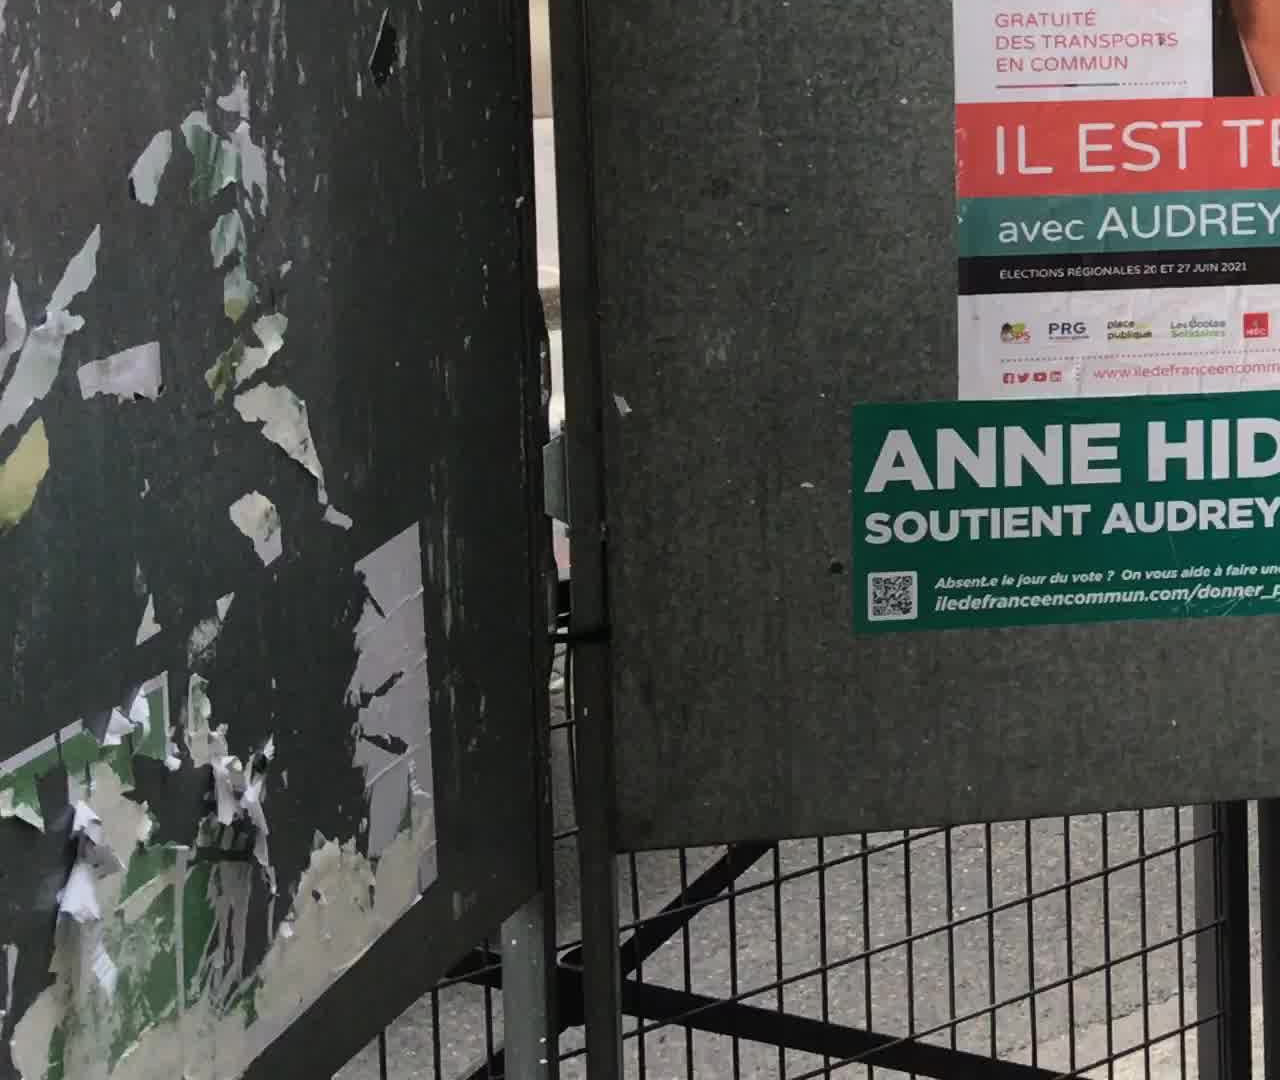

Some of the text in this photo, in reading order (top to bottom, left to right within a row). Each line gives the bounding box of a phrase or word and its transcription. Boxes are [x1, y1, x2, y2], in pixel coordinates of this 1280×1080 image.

[995, 8, 1096, 27] GRATUITÉ
[996, 32, 1178, 50] DES TRANSPORTS
[997, 55, 1128, 72] EN COMMUN
[995, 124, 1052, 174] IL
[1078, 120, 1202, 173] EST
[999, 216, 1084, 244] avec
[1143, 265, 1157, 274] 20
[1160, 264, 1175, 274] ET
[1177, 264, 1191, 273] 27
[1193, 263, 1219, 272] JUIN
[1221, 262, 1247, 272] 2021
[1049, 322, 1087, 335] PRG
[864, 421, 1121, 493] ANNE
[864, 504, 1092, 545] SOUTIENT
[1001, 574, 1014, 585] le
[1016, 573, 1045, 587] jour
[1050, 572, 1067, 584] du
[1072, 572, 1103, 583] vote
[1121, 570, 1141, 580] On
[1145, 569, 1177, 579] vous
[1181, 566, 1210, 578] aide
[1214, 564, 1222, 576] à
[1225, 563, 1257, 576] faire
